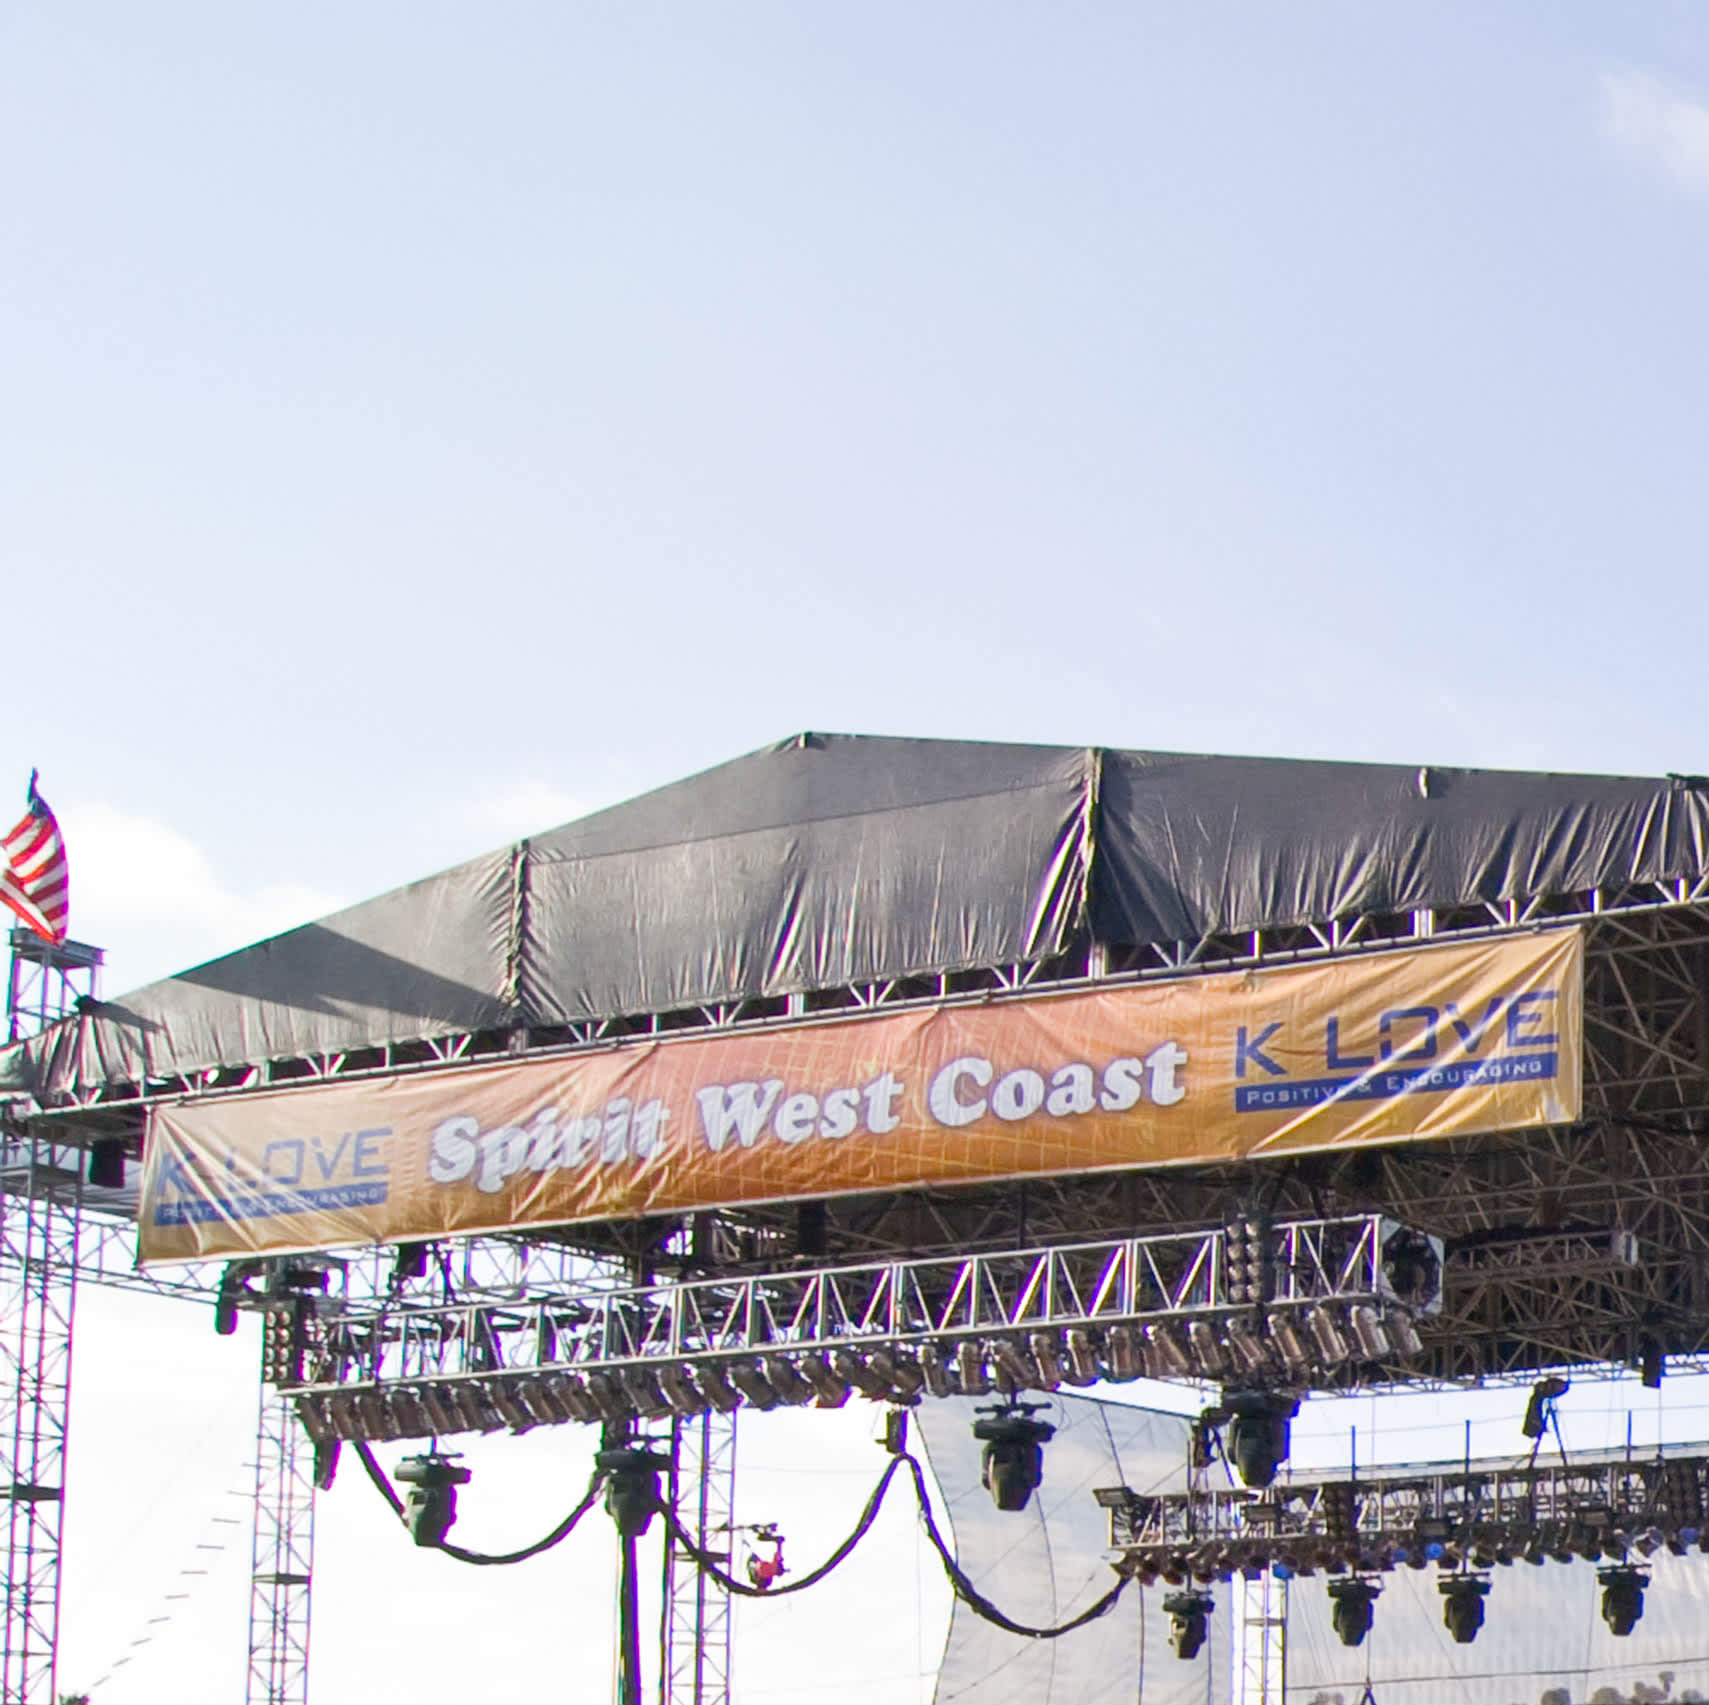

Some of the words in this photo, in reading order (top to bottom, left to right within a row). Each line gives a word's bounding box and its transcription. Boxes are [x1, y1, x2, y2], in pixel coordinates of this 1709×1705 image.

[428, 1096, 671, 1193] Spirit
[696, 1072, 905, 1152] West
[929, 1038, 1190, 1129] Coast
